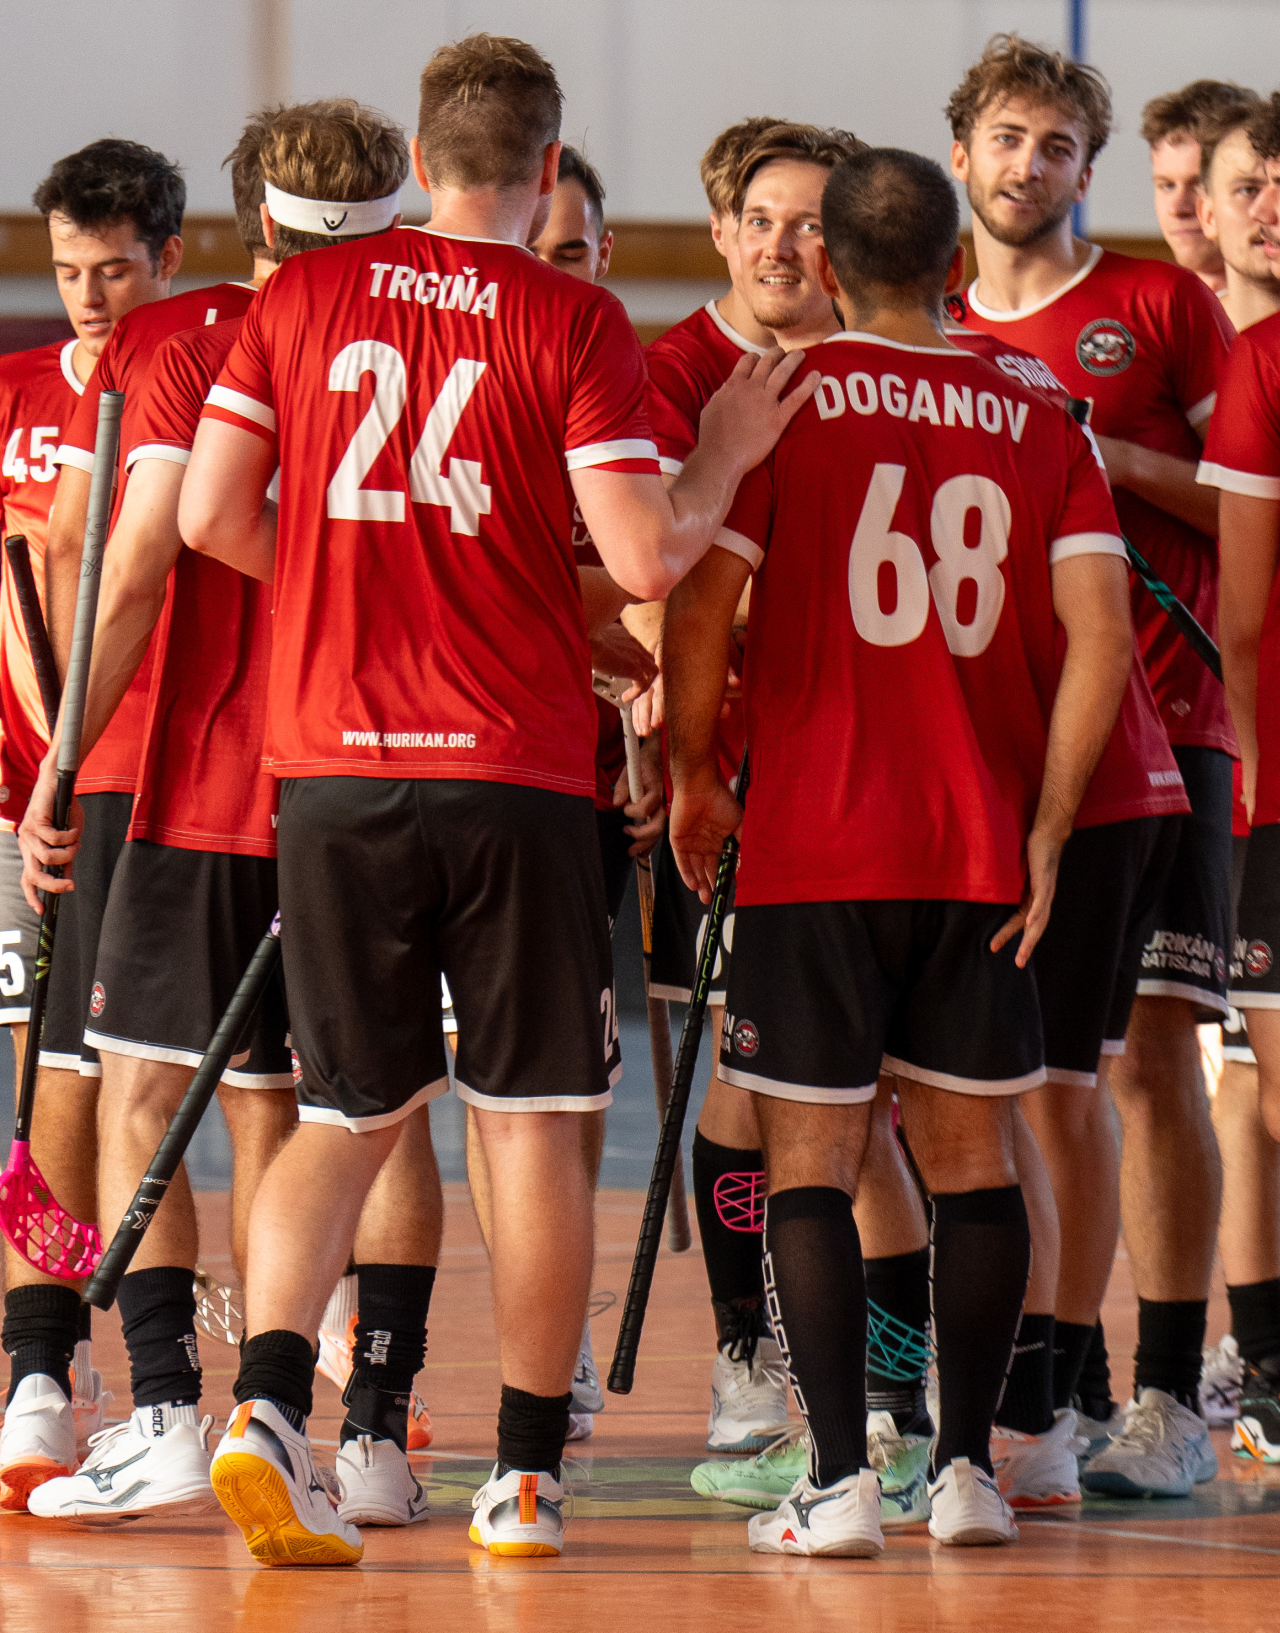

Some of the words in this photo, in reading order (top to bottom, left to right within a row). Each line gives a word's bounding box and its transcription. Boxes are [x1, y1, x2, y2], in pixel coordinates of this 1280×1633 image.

[369, 262, 499, 320] TRGIŇA
[812, 371, 1029, 443] DOGANOV
[2, 426, 59, 483] 45
[327, 339, 491, 537] 24
[848, 462, 1011, 657] 68
[342, 731, 477, 749] WWW.HURIKAN.ORG
[151, 1405, 165, 1438] SOCK
